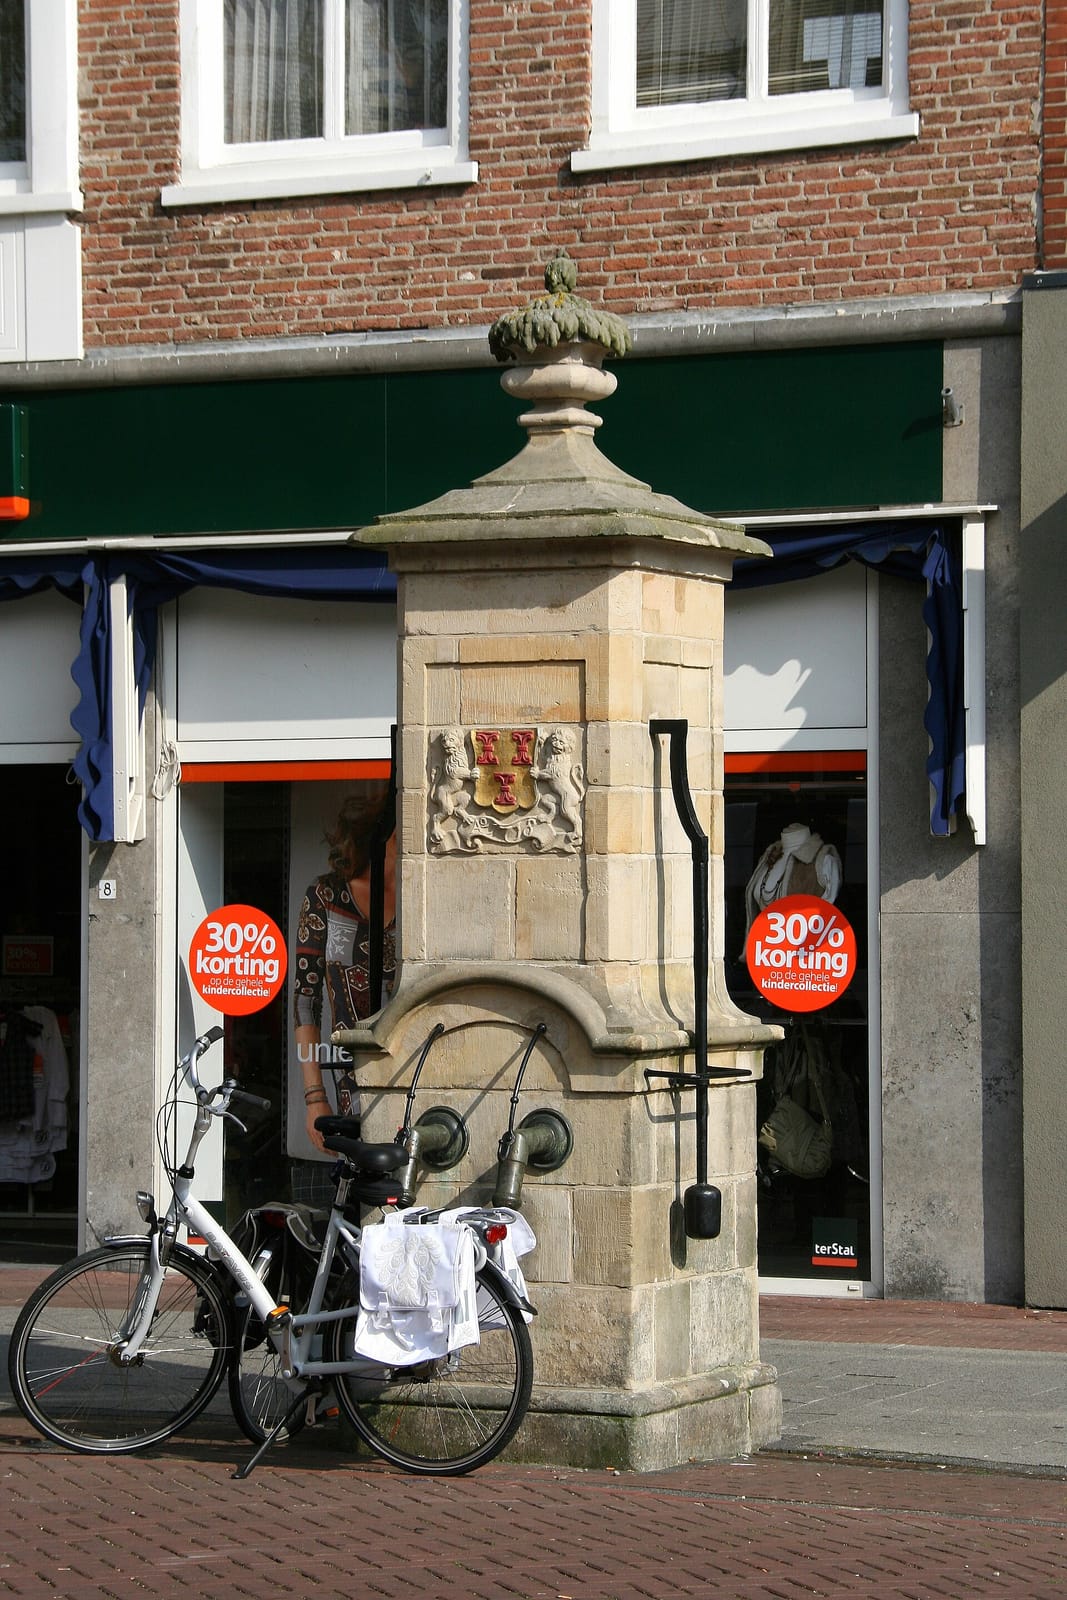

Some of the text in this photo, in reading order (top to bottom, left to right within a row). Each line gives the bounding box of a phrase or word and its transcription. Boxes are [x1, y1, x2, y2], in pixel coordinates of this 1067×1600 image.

[103, 882, 112, 896] 8
[765, 912, 845, 948] 30%
[205, 922, 276, 954] 30%
[196, 949, 280, 983] korting
[755, 940, 848, 978] korting
[210, 976, 264, 989] op de gehele
[770, 970, 830, 982] op de gehele
[202, 984, 271, 997] kindercollectie!
[761, 978, 838, 993] kindercollectie!
[814, 1242, 855, 1256] terStal
